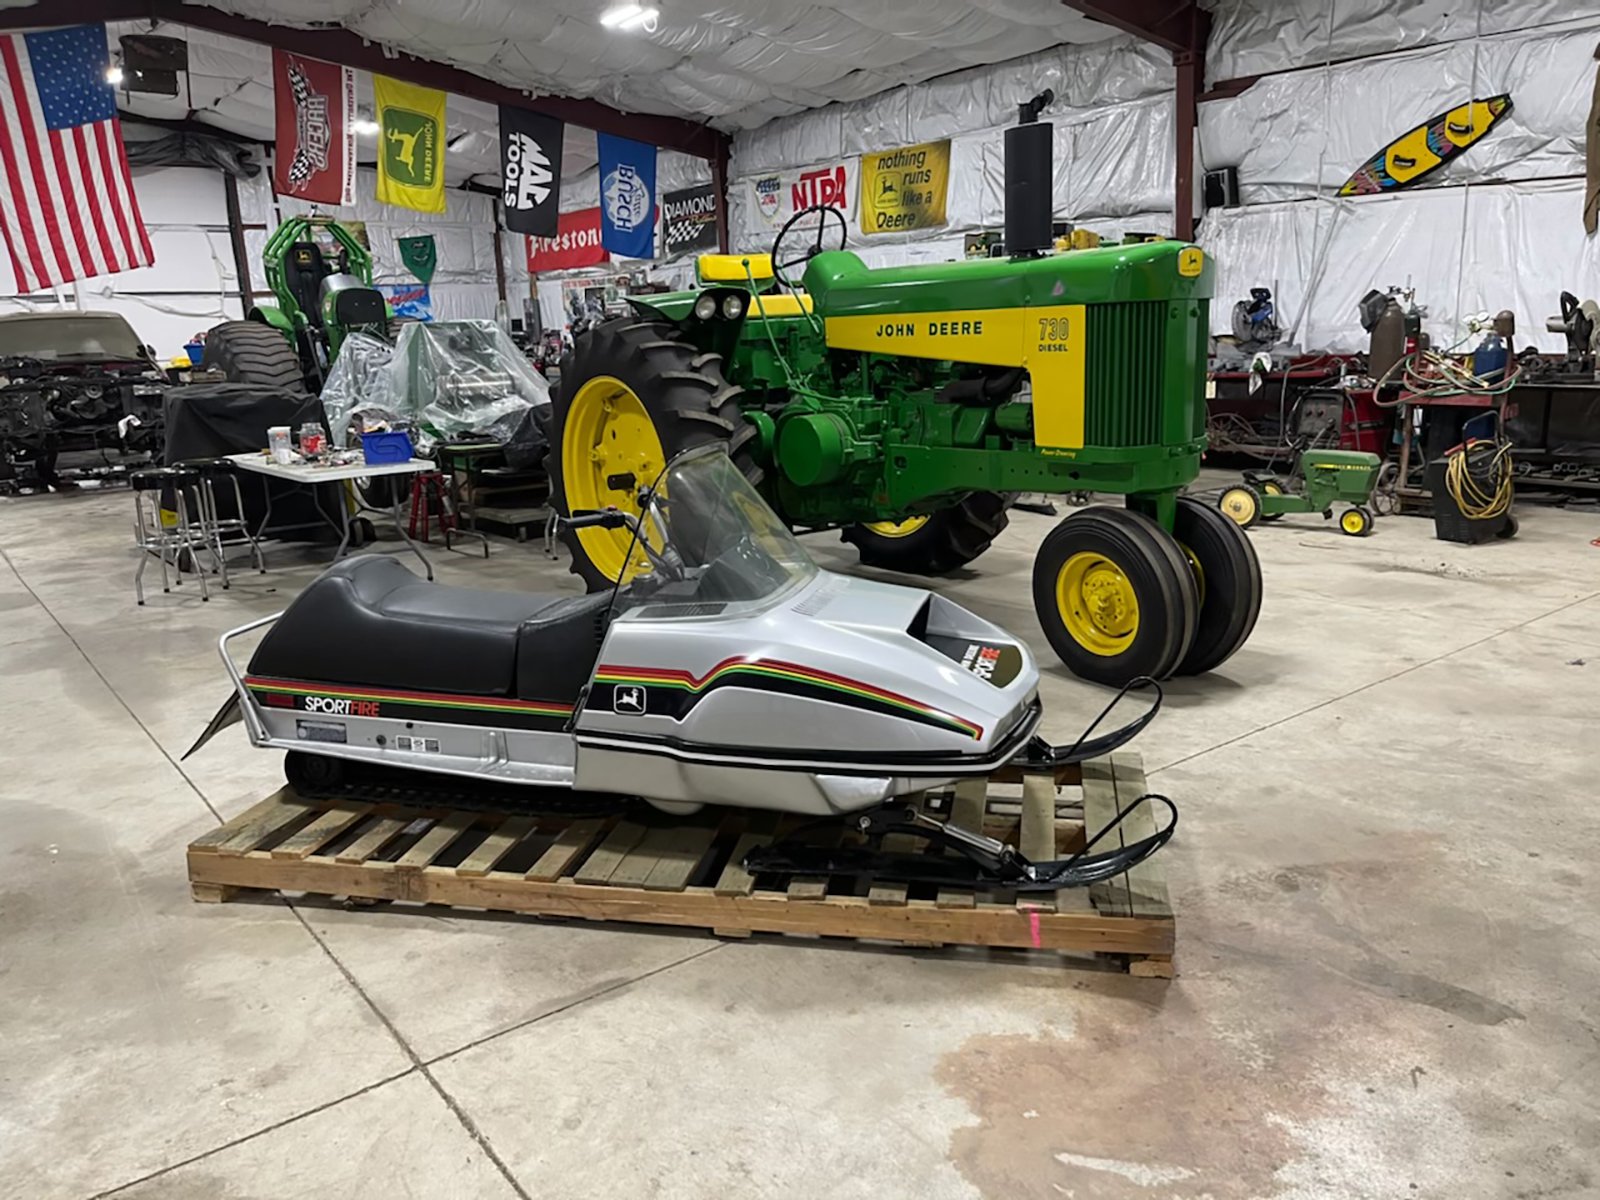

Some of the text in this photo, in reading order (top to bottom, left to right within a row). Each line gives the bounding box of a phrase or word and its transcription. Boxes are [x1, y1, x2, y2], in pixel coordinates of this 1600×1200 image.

[504, 132, 520, 208] TOOLS
[878, 150, 926, 170] nothing
[517, 133, 553, 210] MAC
[902, 169, 932, 186] runs
[791, 165, 847, 213] NTPA
[902, 189, 933, 206] like a
[664, 194, 716, 219] DIAMOND
[876, 211, 916, 228] Deere
[529, 228, 602, 259] Fireston
[876, 321, 983, 337] JOHN DEERE
[1038, 317, 1070, 341] 730
[1038, 344, 1069, 352] DIESEL
[304, 696, 380, 716] SPORTFIRE
